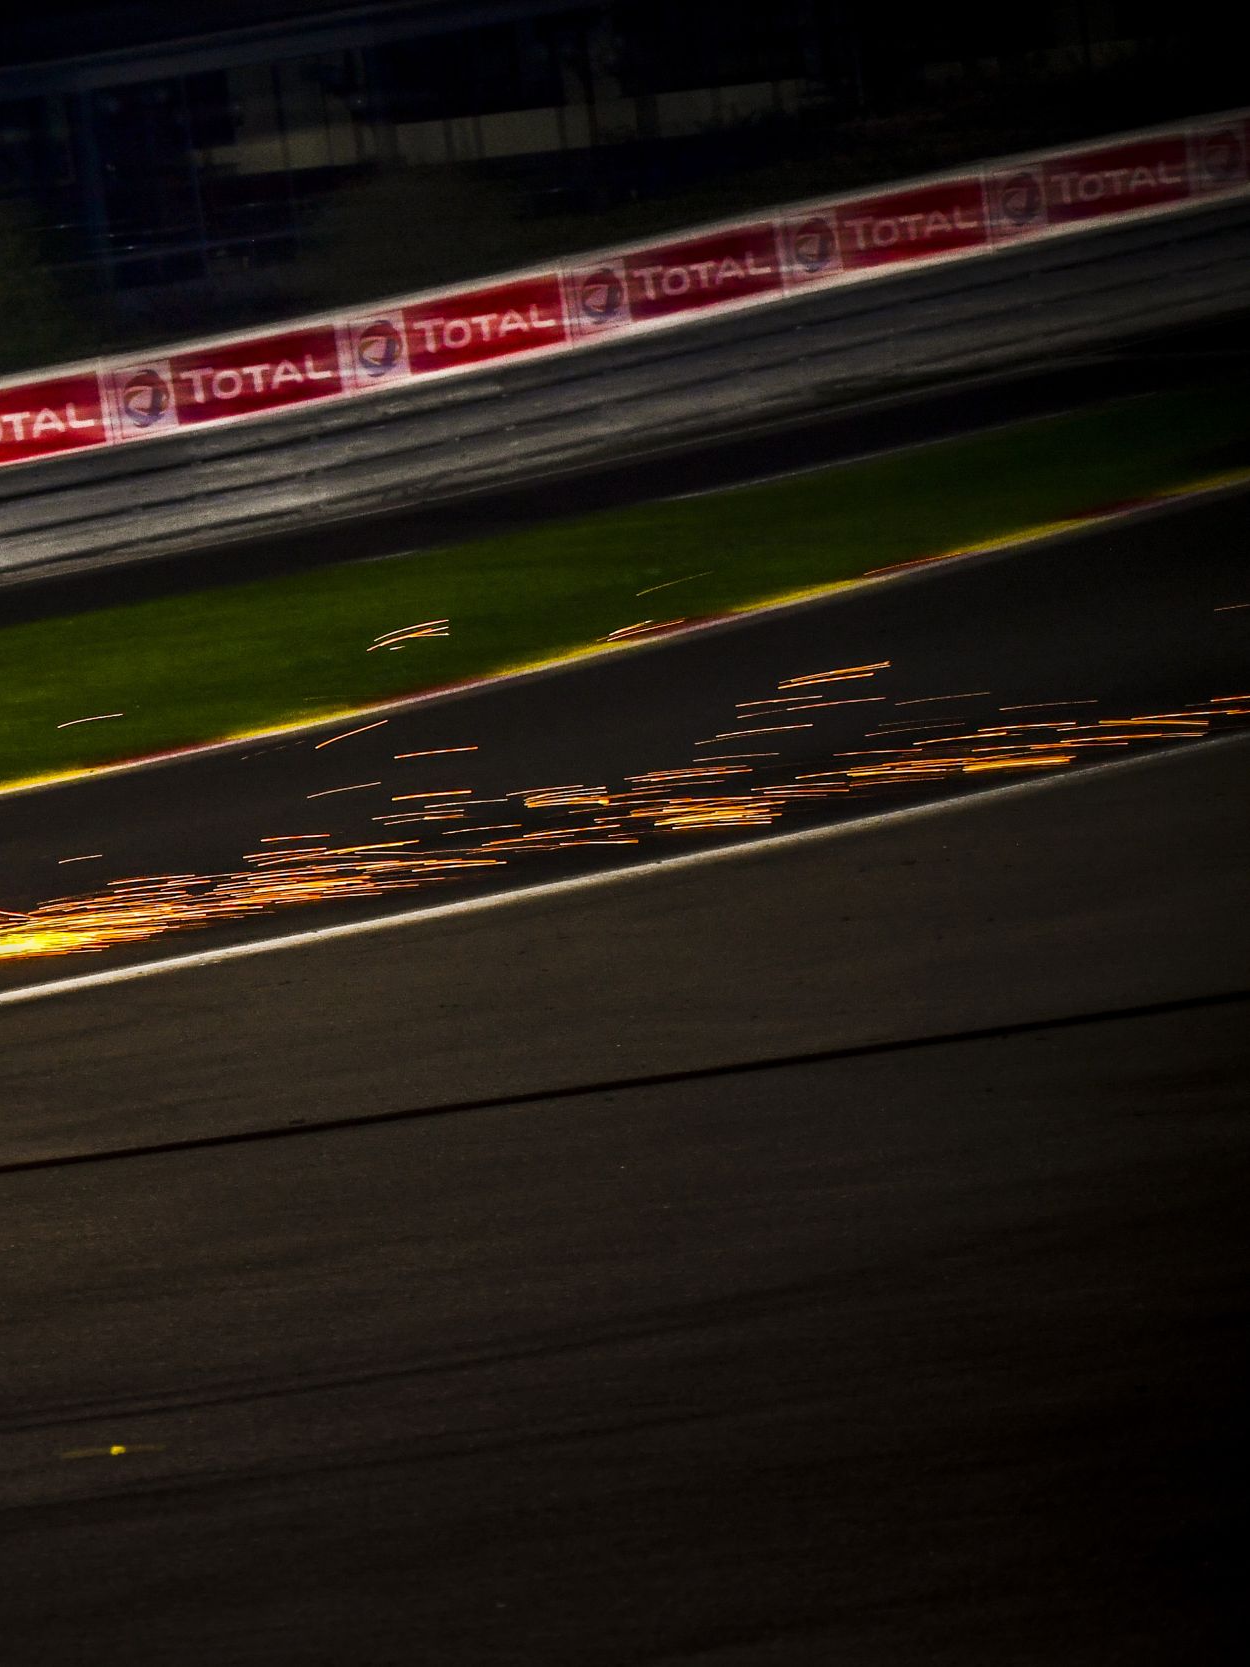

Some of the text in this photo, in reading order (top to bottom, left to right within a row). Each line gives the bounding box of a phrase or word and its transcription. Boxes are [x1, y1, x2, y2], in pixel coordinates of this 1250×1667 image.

[1051, 160, 1182, 204] TOTAL
[844, 205, 978, 251] TOTAL
[633, 252, 772, 302] TOTAL
[412, 304, 556, 354] TOTAL
[179, 355, 334, 404] TOTAL
